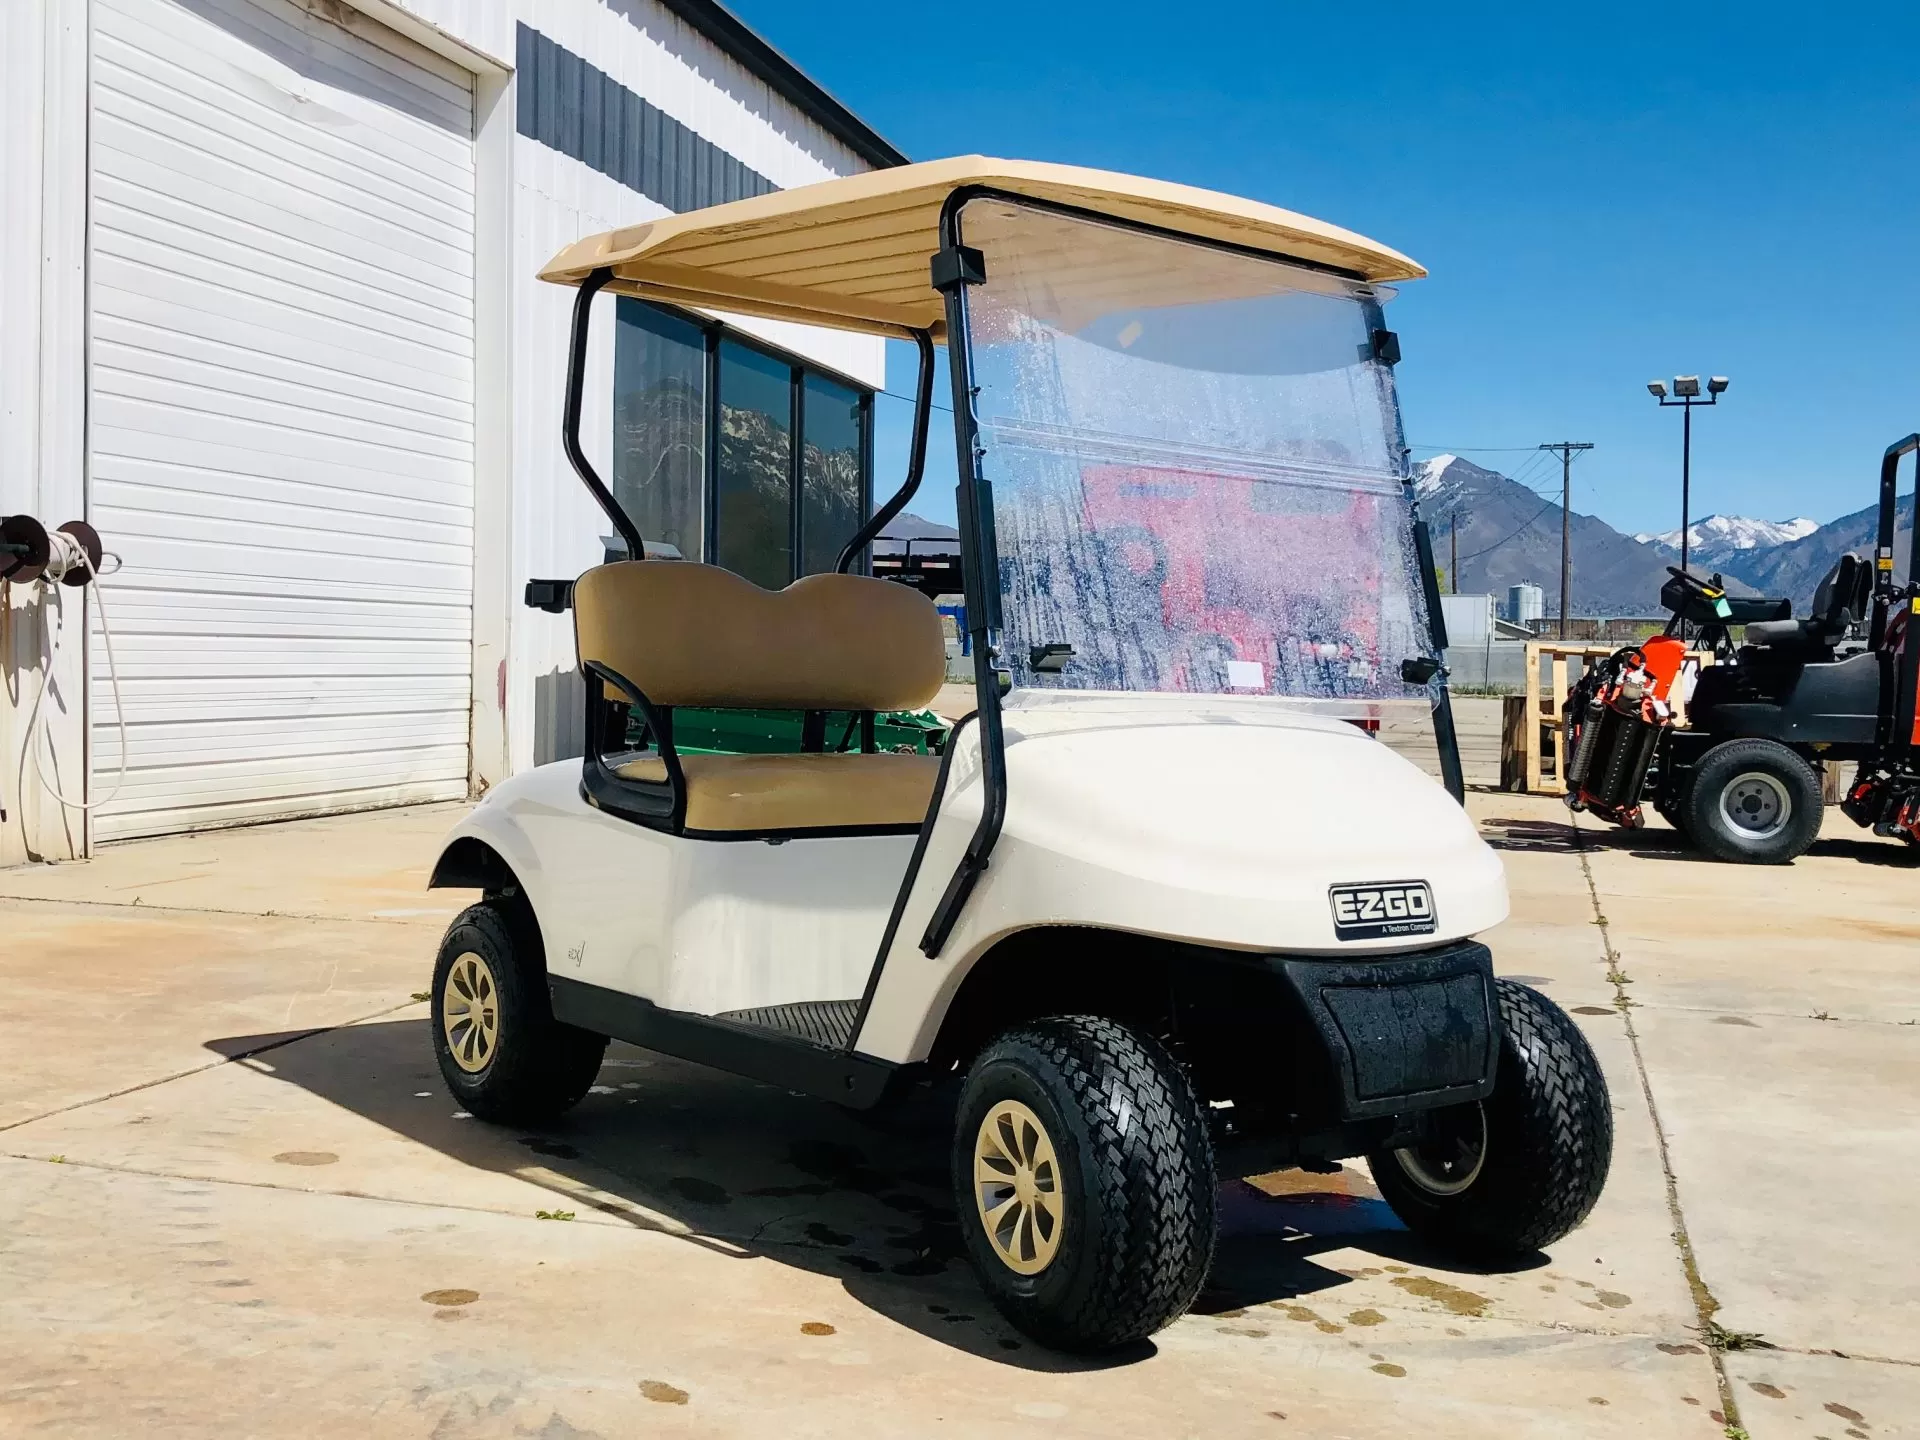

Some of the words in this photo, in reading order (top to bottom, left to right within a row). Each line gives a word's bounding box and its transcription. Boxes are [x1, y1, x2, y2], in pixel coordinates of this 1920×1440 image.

[1382, 925, 1388, 933] A
[1388, 924, 1410, 933] Textron
[1410, 923, 1435, 931] Company
